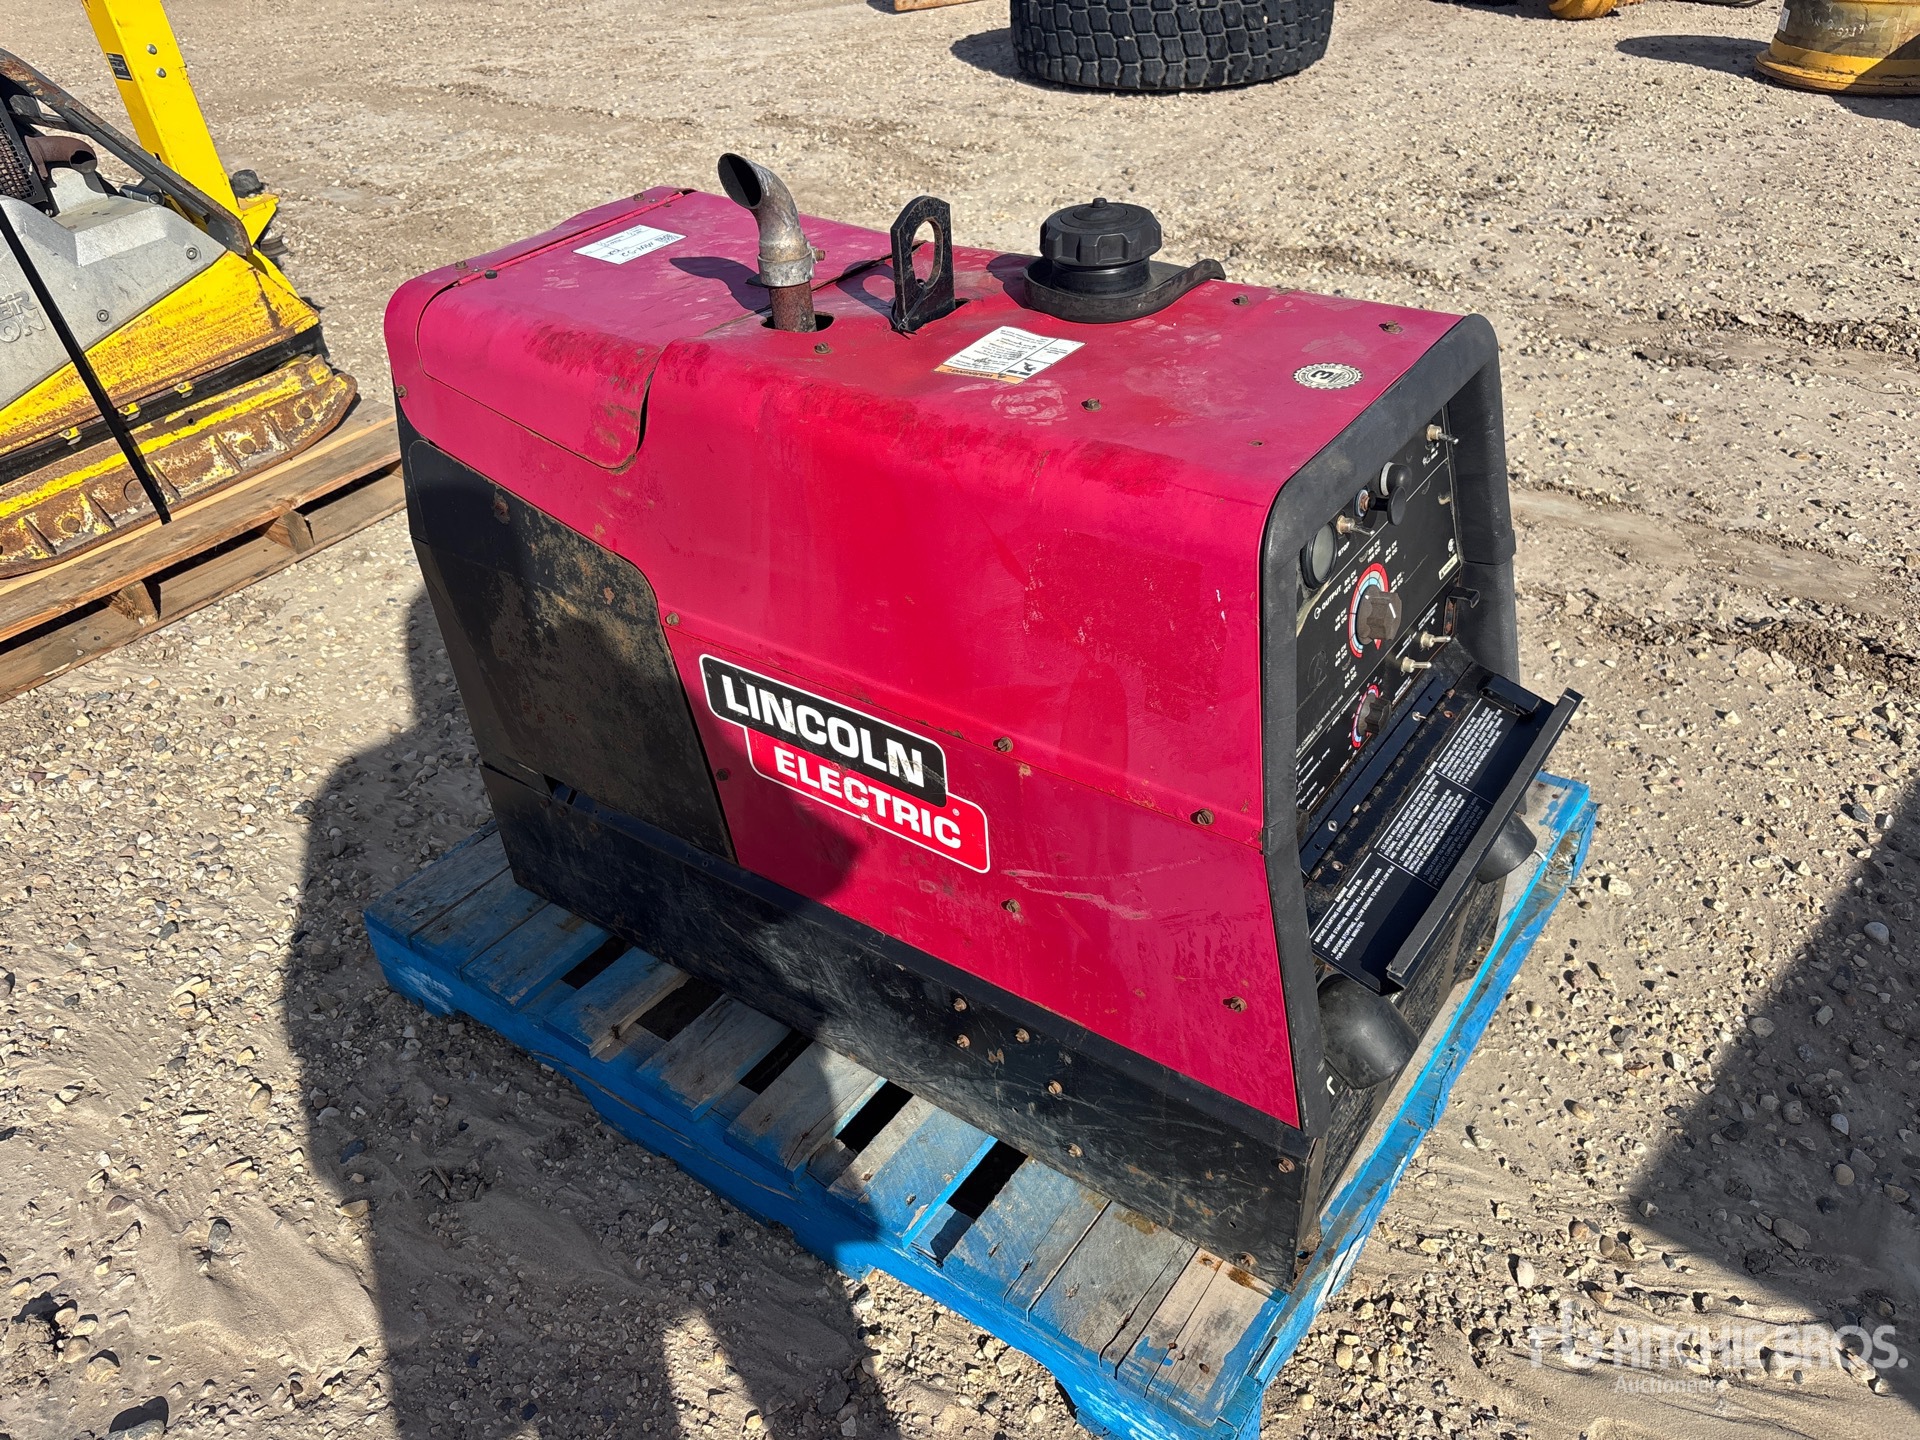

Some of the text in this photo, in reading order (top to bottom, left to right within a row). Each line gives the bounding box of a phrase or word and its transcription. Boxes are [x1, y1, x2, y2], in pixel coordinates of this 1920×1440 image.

[1322, 585, 1342, 610] OUTPUT
[721, 674, 925, 788] LINCOLN
[773, 746, 961, 850] ELECTRIC
[1315, 928, 1327, 942] BEFORE
[1325, 911, 1339, 928] STARTING
[1346, 885, 1358, 898] CHECK
[1323, 933, 1335, 948] BEFORE
[1345, 902, 1357, 917] REMOVE
[1363, 879, 1374, 891] POWER
[1332, 939, 1344, 953] BEFORE
[1354, 909, 1365, 921] ALLOW
[1362, 897, 1373, 910] ENGINE
[1374, 884, 1382, 892] RUN
[1382, 873, 1390, 881] LOW
[1387, 865, 1395, 874] IDLE
[1335, 952, 1343, 960] FOR
[1341, 936, 1354, 952] SEVERAL
